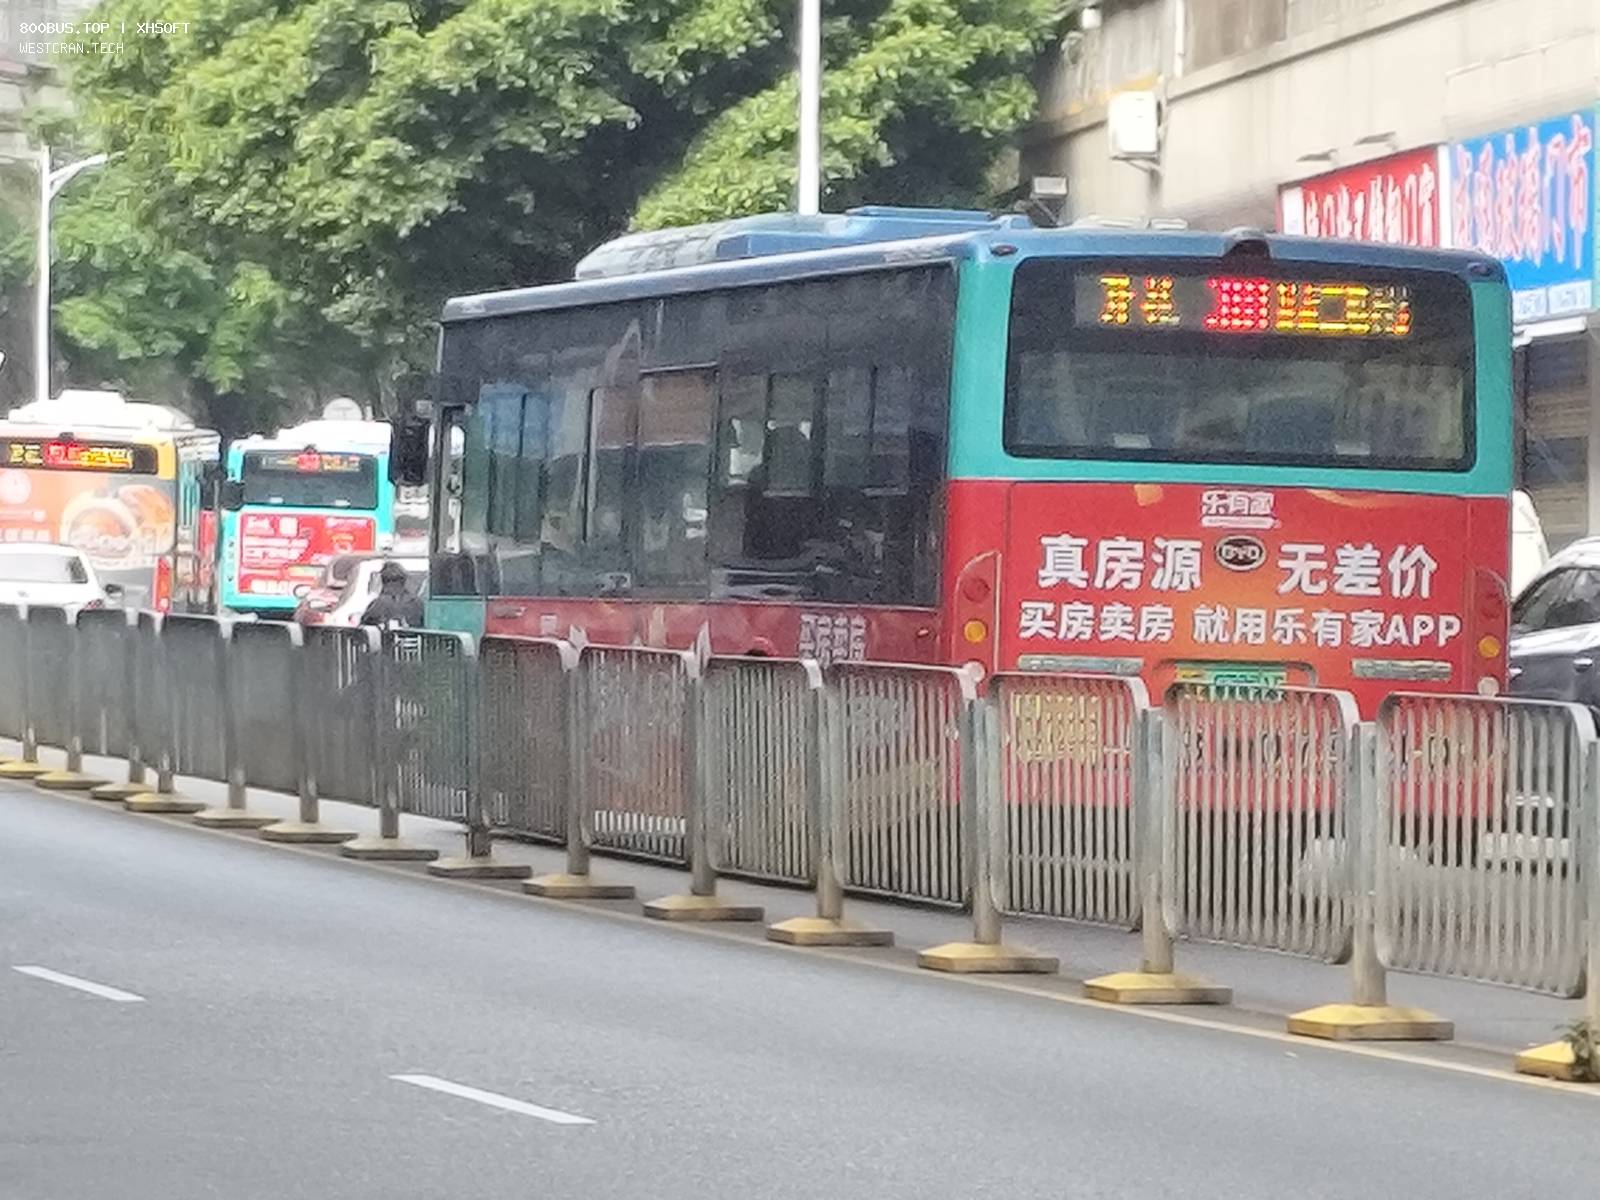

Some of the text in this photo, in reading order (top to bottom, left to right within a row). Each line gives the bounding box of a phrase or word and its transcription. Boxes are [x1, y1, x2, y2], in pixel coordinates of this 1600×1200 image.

[1038, 533, 1438, 599] 真房源 无差价
[1019, 600, 1461, 647] 买房卖房 就用乐有家APP
